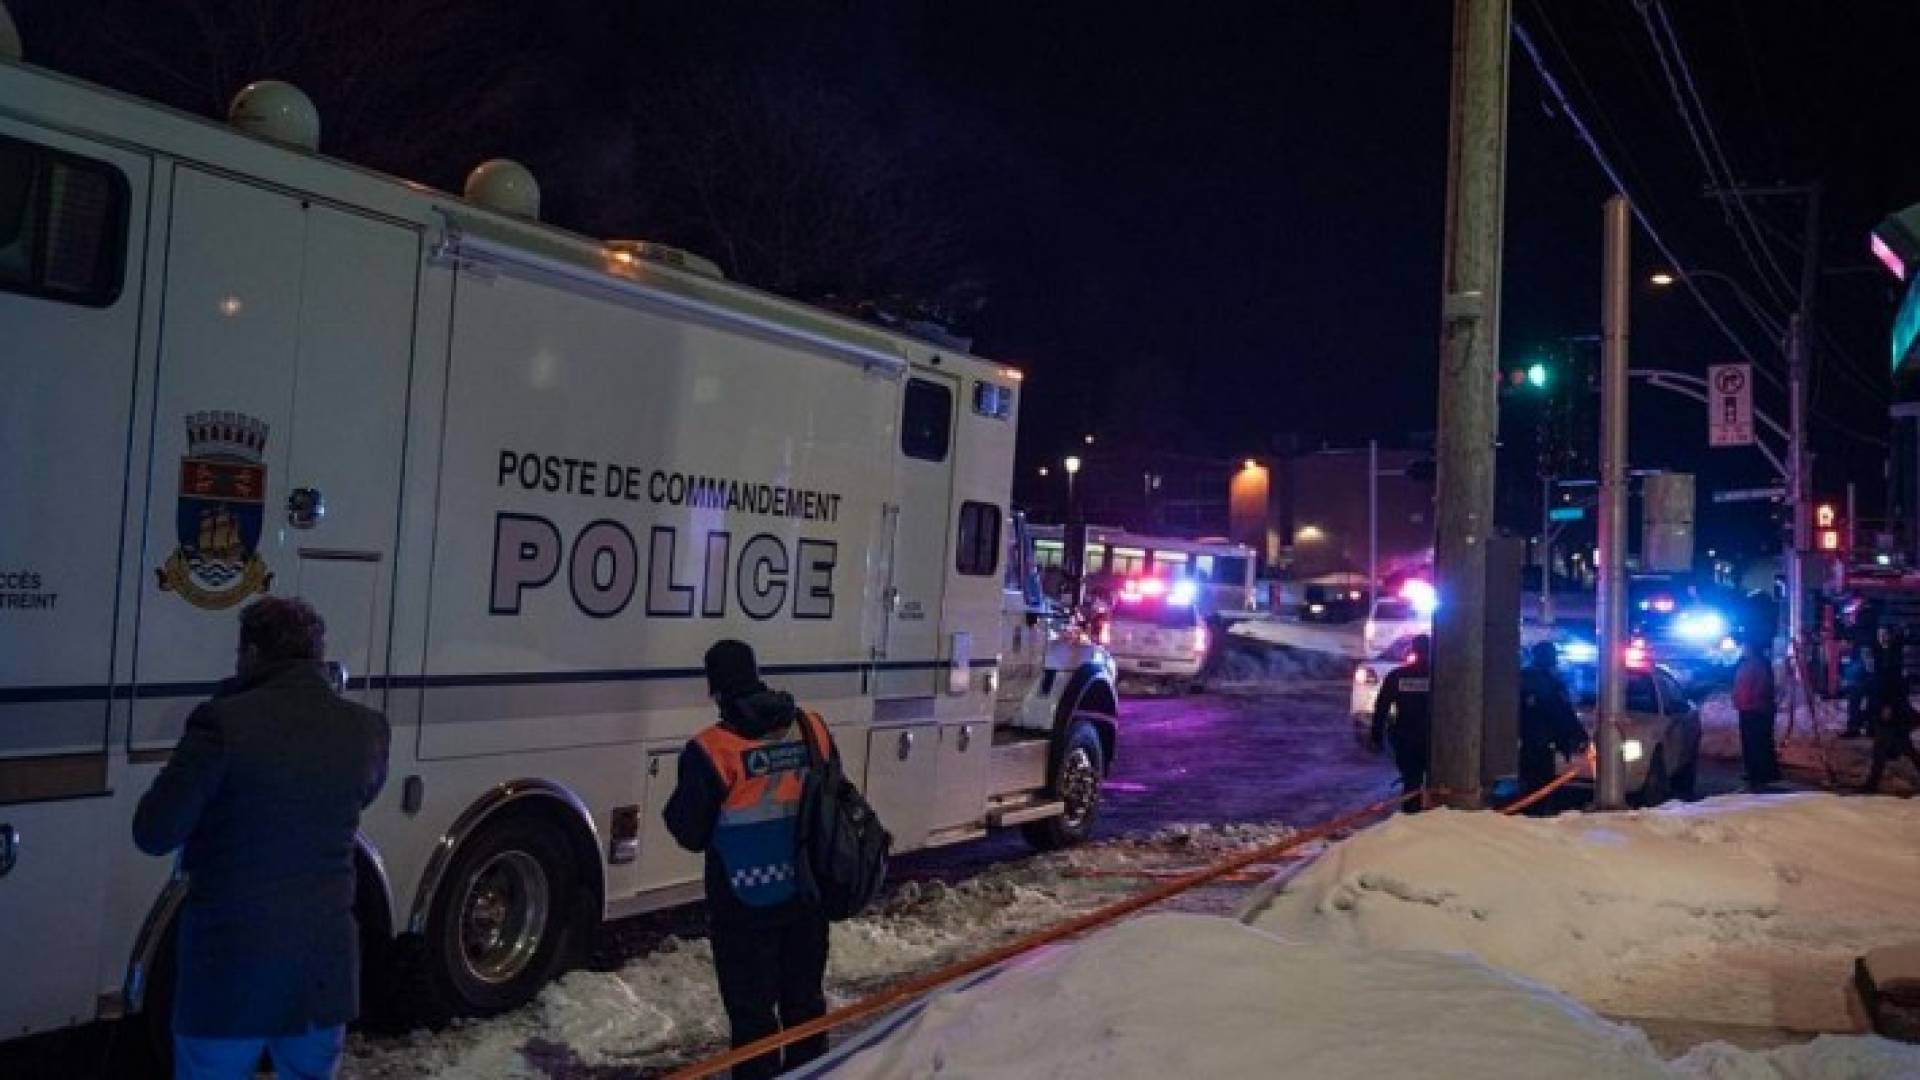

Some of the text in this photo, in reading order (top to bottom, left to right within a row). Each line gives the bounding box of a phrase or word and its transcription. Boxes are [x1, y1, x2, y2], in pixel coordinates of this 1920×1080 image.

[497, 449, 842, 522] POSTE DE COMMANDEMENT
[489, 511, 838, 621] POLICE
